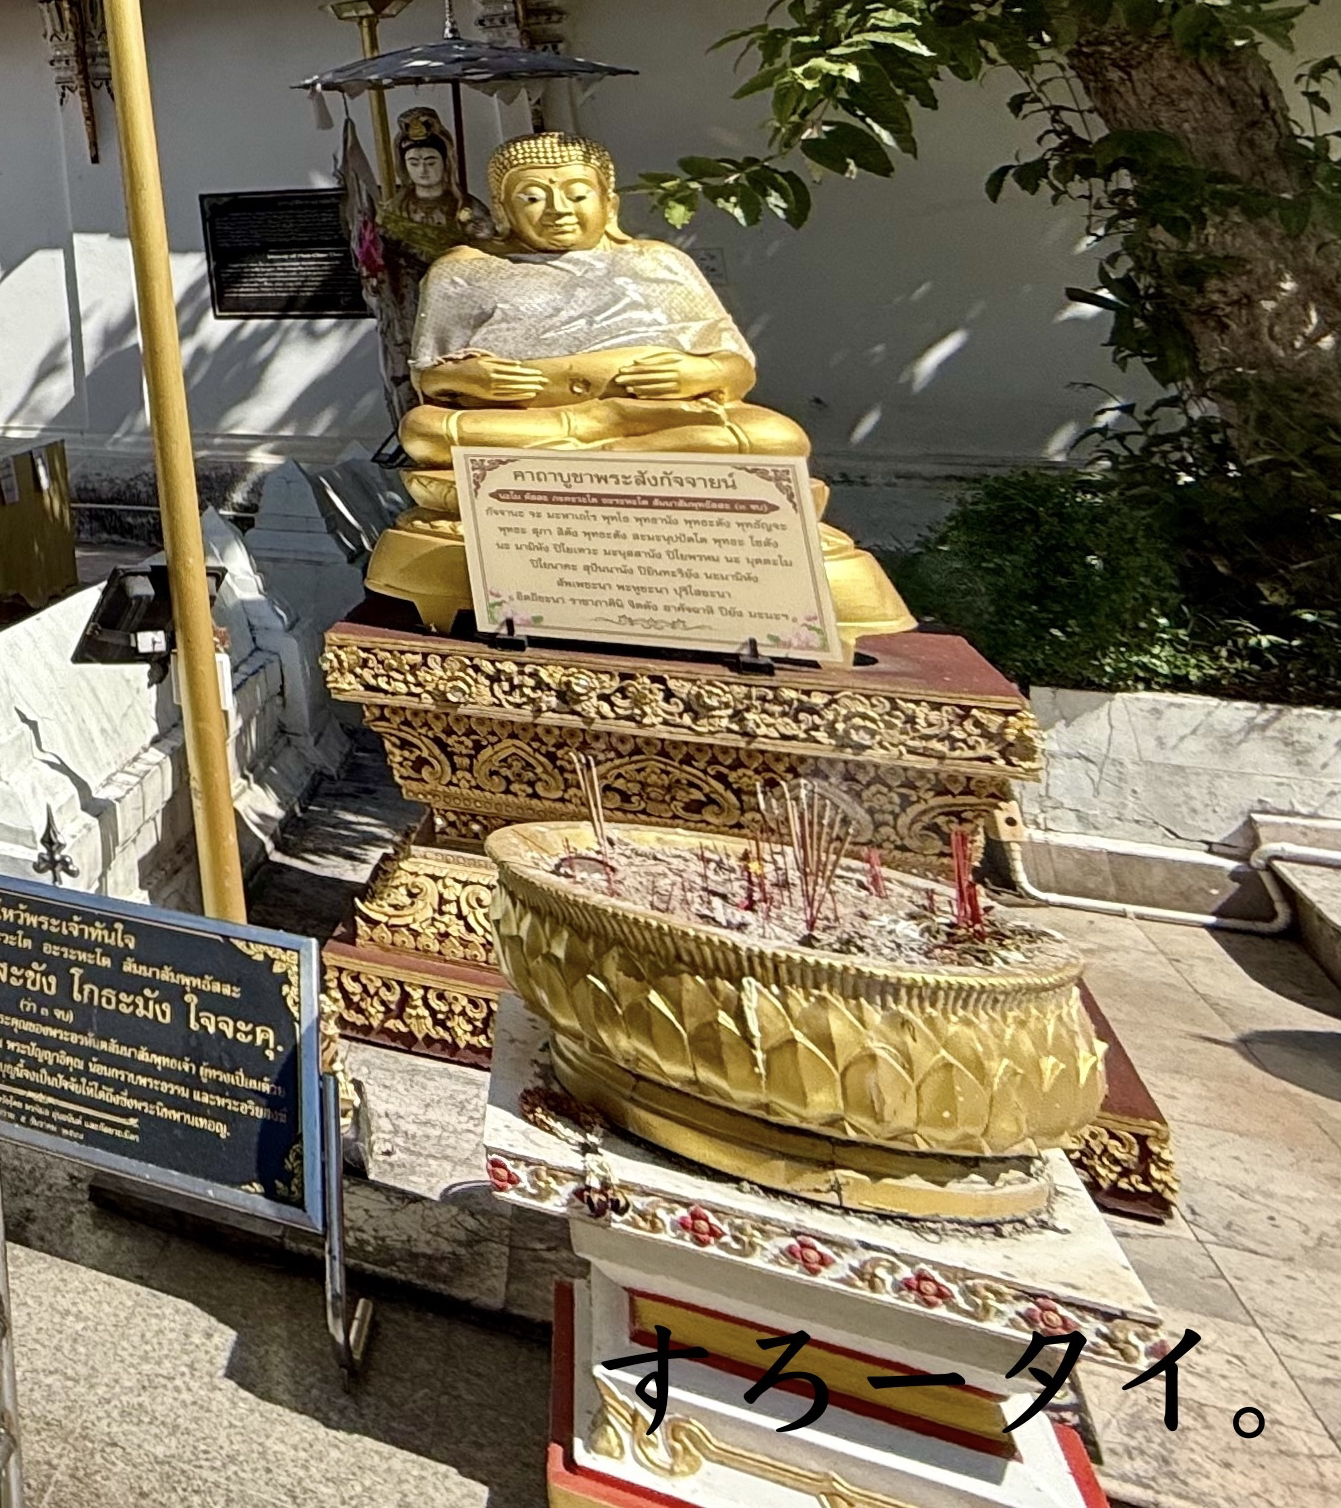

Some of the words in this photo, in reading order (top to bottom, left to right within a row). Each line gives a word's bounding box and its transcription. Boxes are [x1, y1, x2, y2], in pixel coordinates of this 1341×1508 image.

[512, 470, 737, 489] คาถาบูชาพระสังกัจจายน์
[42, 942, 111, 968] อะระหะโต
[122, 956, 240, 998] สัมมาสัมพุทธัสสะ
[69, 966, 170, 1023] โกธะมัง
[183, 993, 283, 1060] ใจจะคุ.
